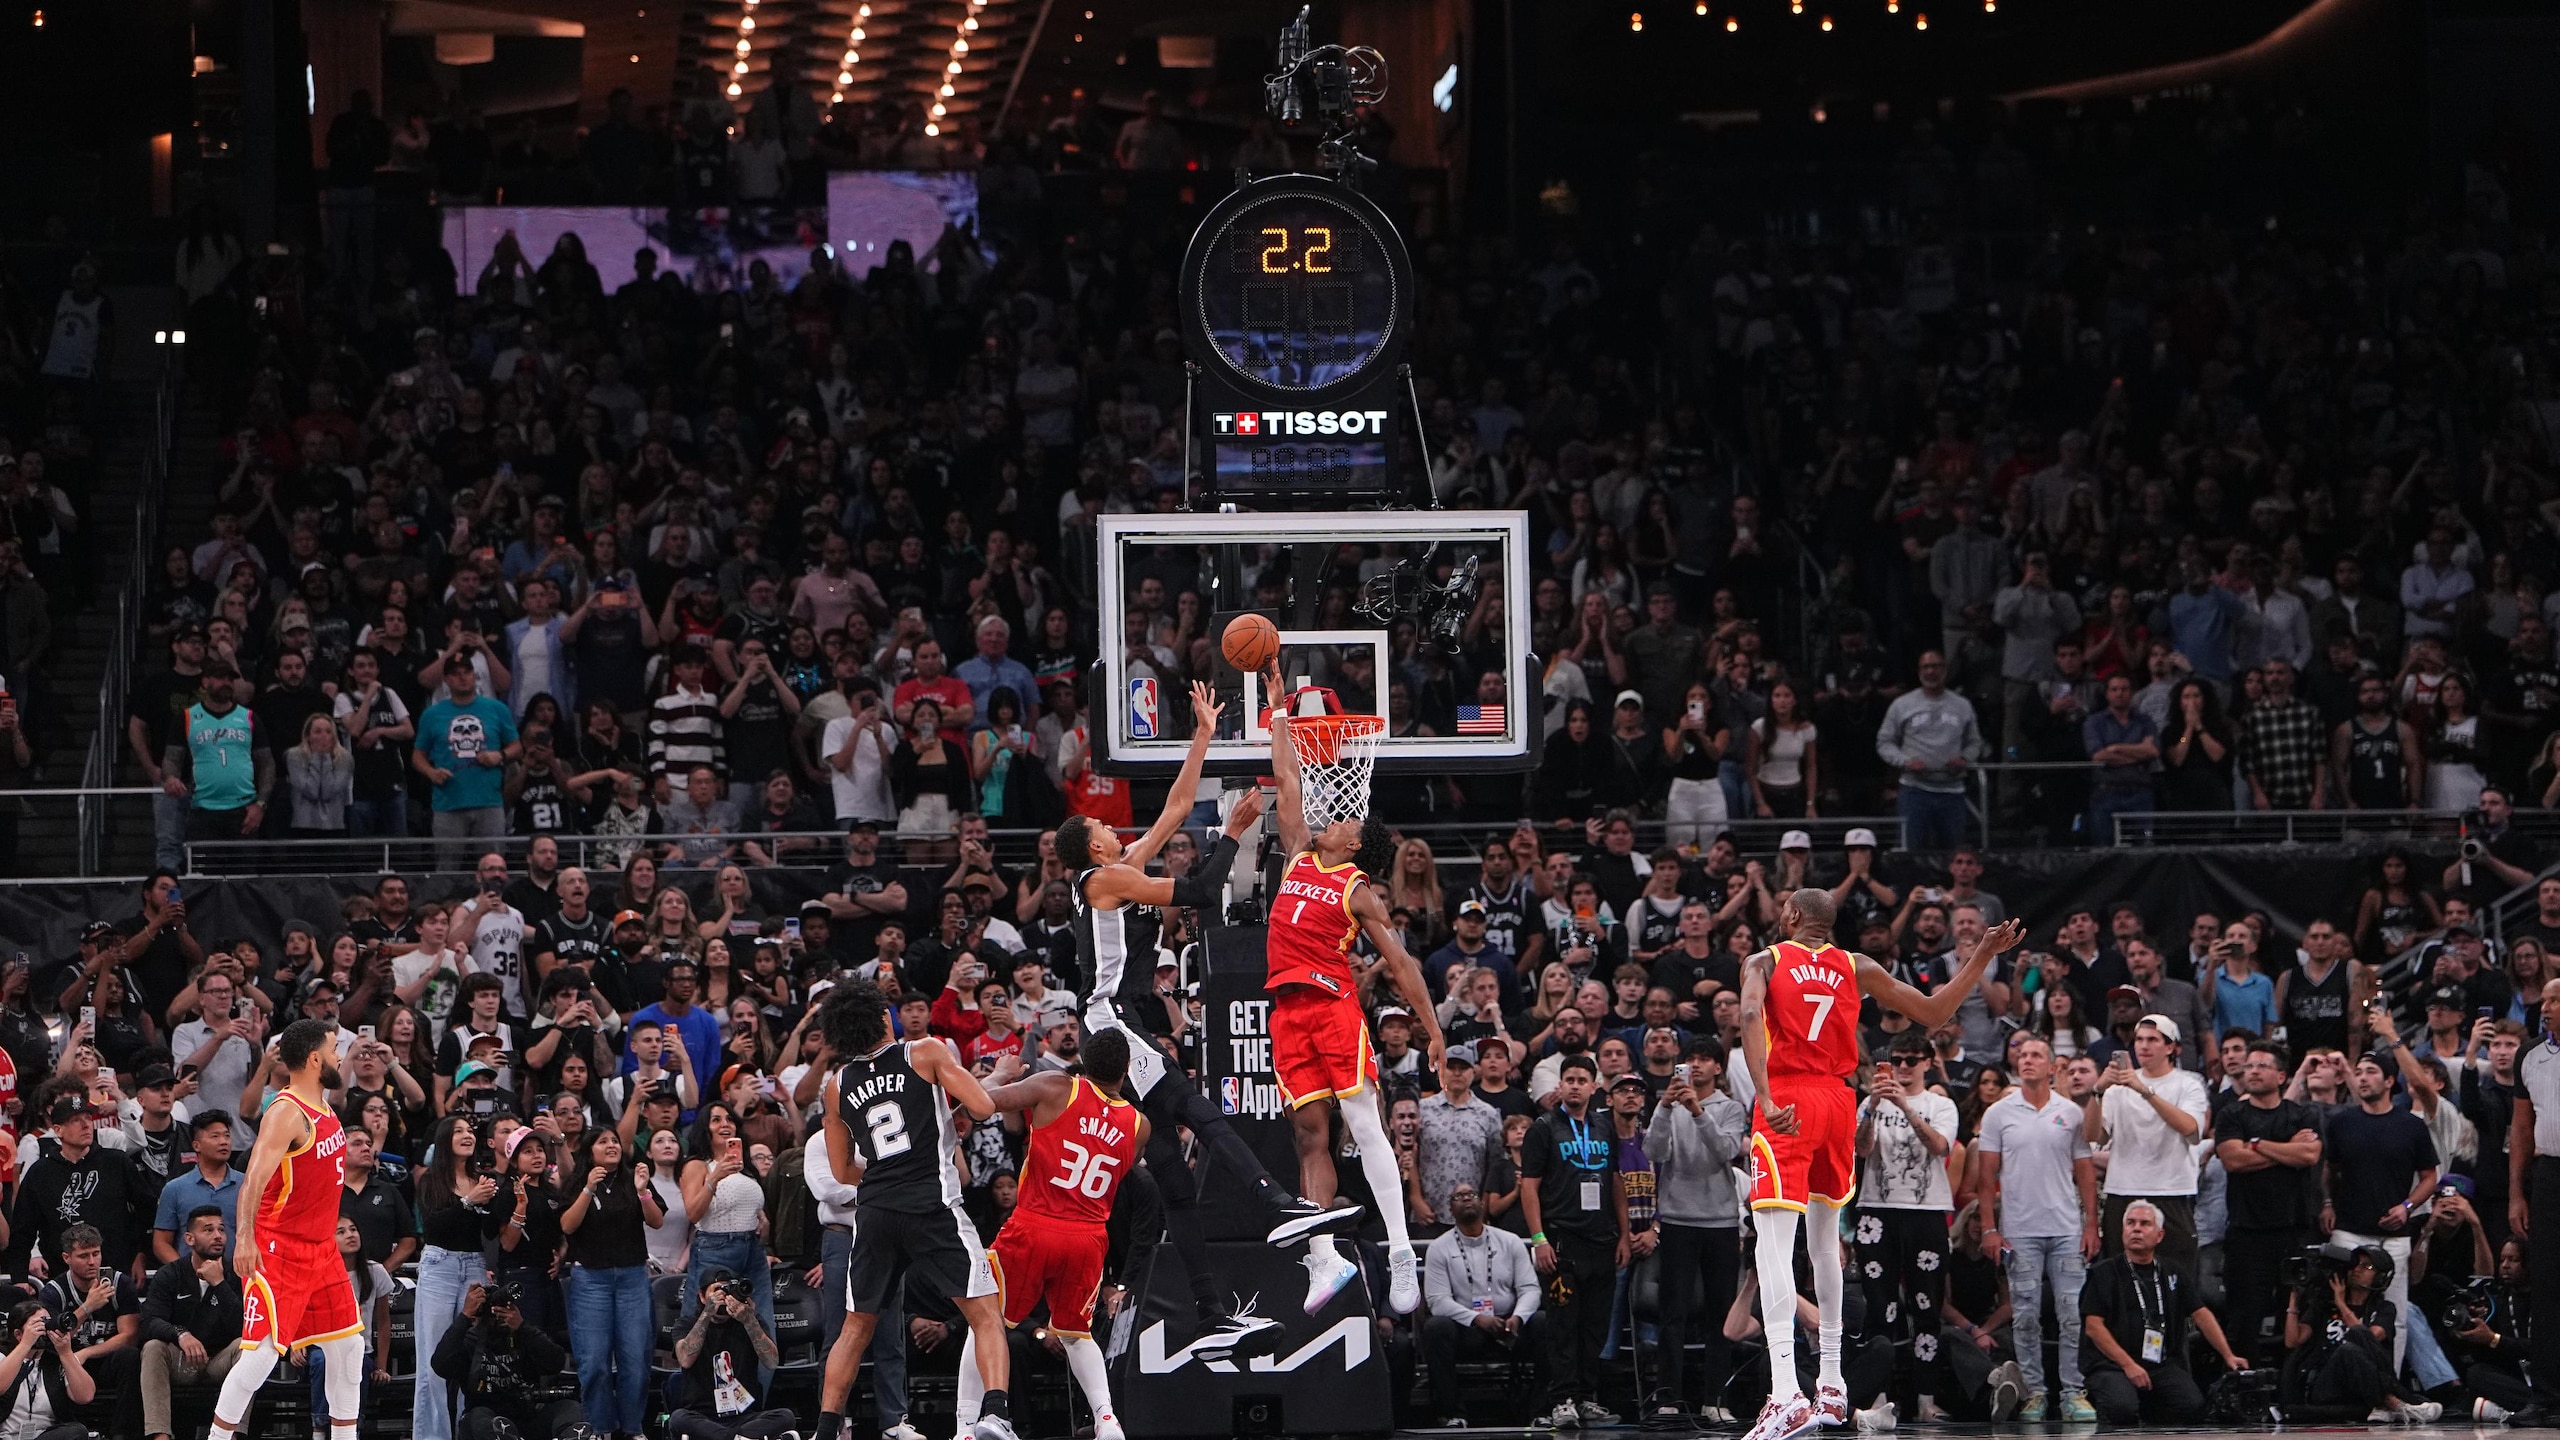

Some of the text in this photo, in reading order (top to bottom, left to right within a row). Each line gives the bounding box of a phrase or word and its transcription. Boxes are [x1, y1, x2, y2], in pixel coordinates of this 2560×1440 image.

[1262, 228, 1331, 274] 2.2
[1262, 411, 1387, 435] TISSOT
[195, 728, 246, 745] SPURS
[1135, 724, 1149, 735] NBA
[218, 747, 227, 767] 1
[2374, 758, 2385, 779] 1
[1087, 773, 1114, 796] 35
[532, 802, 563, 829] 21
[1279, 879, 1343, 906] ROCKETS
[1291, 900, 1307, 925] 1
[557, 939, 600, 955] SPRS
[493, 951, 519, 977] 32
[1789, 964, 1844, 990] DURANT
[1229, 1000, 1270, 1036] GET
[1803, 993, 1835, 1042] 7
[1229, 1038, 1272, 1073] THE
[846, 1073, 905, 1110] HARPER
[1241, 1077, 1283, 1120] App
[316, 1127, 346, 1160] ROCKE
[865, 1099, 912, 1161] 2
[1079, 1116, 1125, 1147] SMART
[1559, 1140, 1610, 1161] prme
[335, 1156, 345, 1186] 5
[1049, 1139, 1121, 1199] 36
